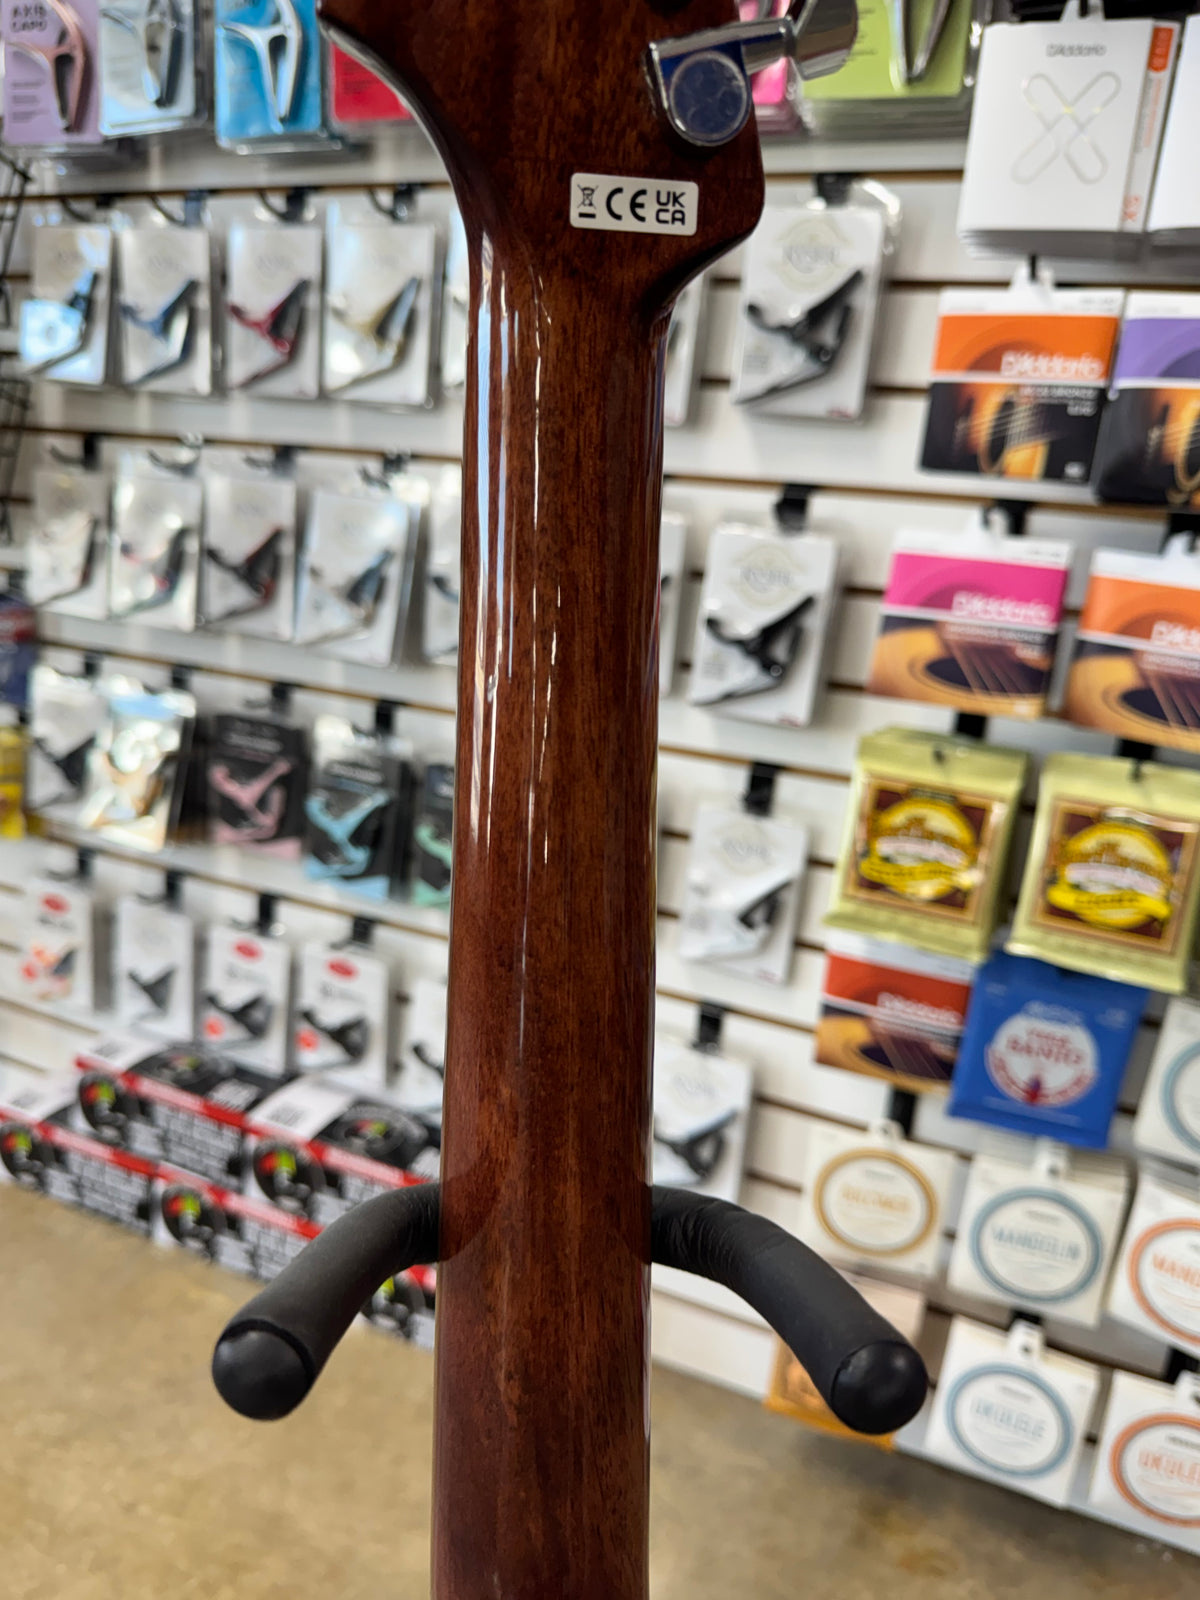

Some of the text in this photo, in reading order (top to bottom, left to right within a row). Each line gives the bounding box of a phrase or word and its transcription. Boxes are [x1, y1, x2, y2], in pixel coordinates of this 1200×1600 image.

[11, 20, 47, 32] CAPO
[606, 187, 648, 223] CE
[656, 190, 686, 208] UK
[655, 208, 686, 226] CA
